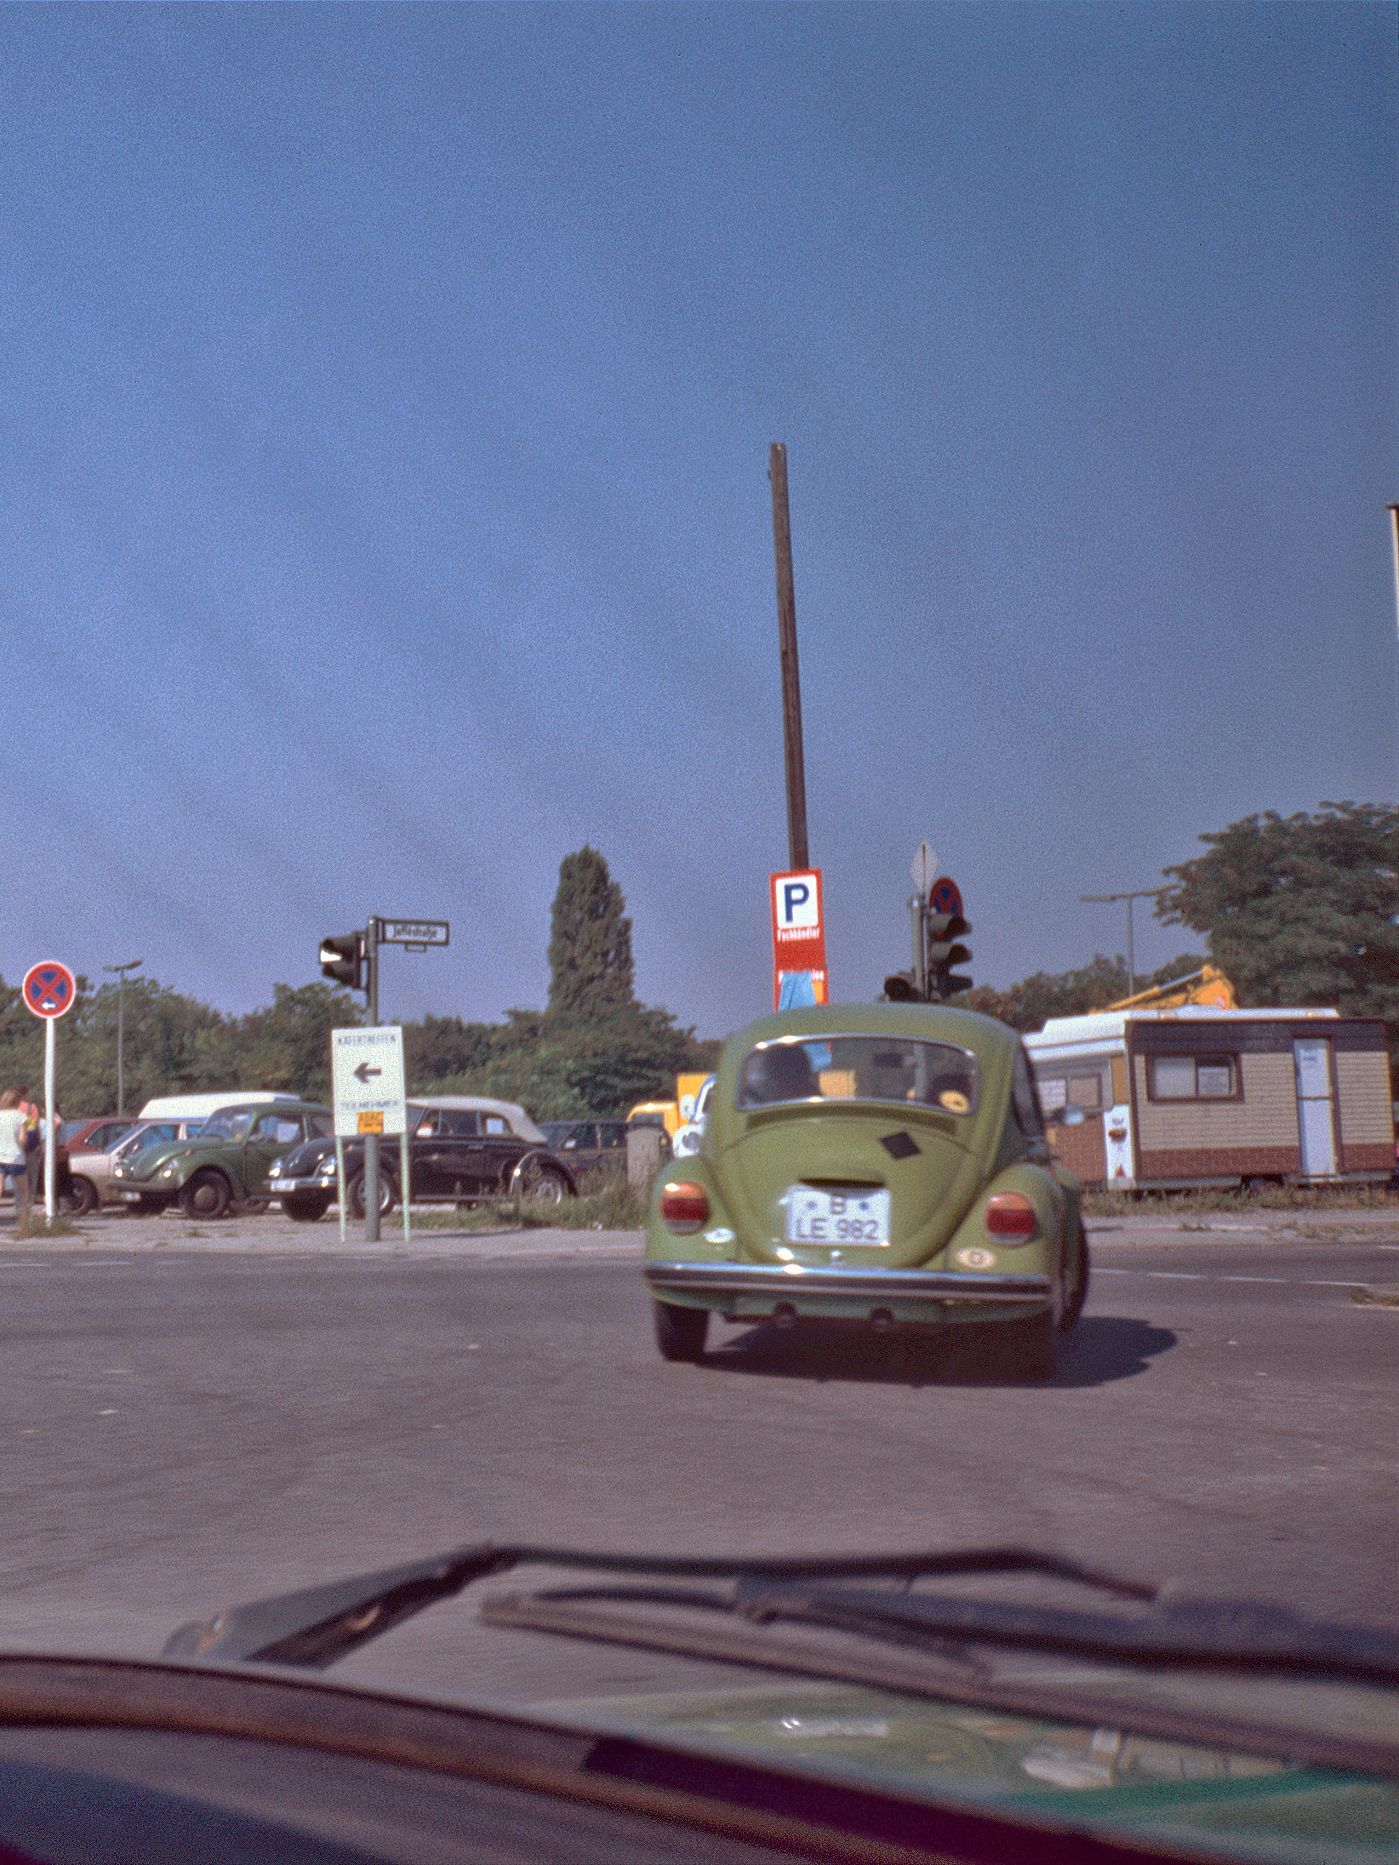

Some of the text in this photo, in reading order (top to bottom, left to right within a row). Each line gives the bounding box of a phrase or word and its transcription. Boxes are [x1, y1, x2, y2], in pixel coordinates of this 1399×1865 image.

[784, 883, 810, 923] P
[777, 927, 820, 941] Fachhändler
[830, 1194, 845, 1215] B
[796, 1217, 879, 1239] LE 982
